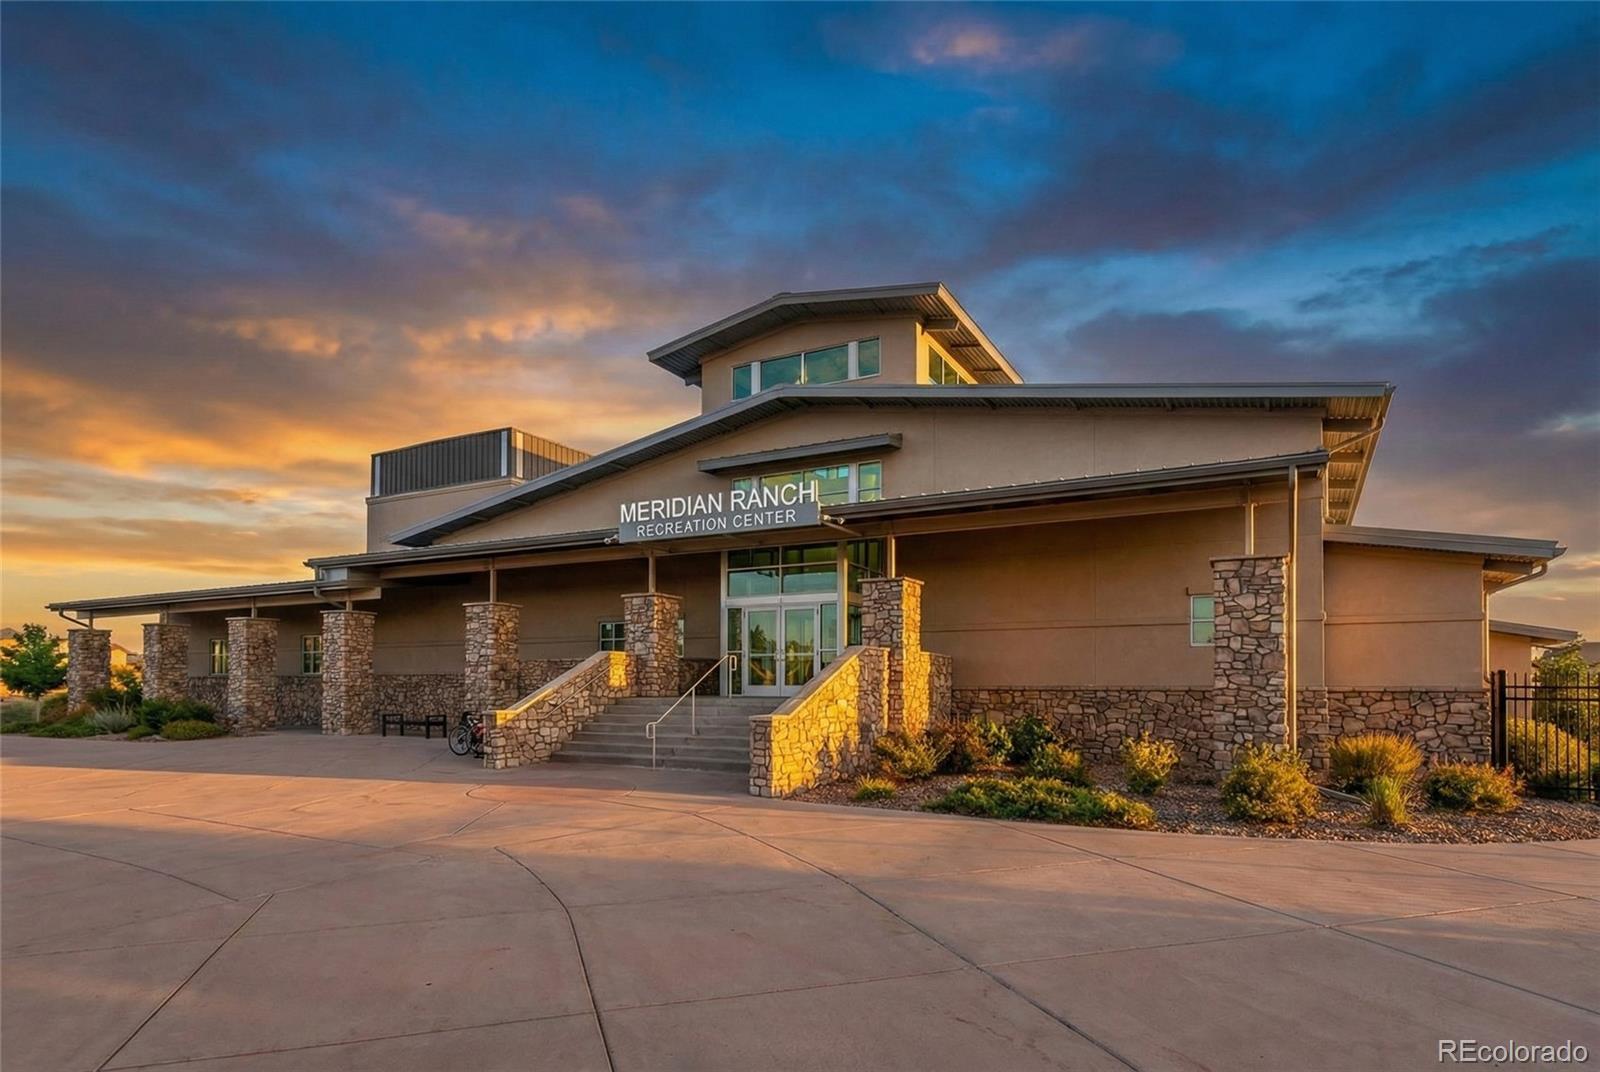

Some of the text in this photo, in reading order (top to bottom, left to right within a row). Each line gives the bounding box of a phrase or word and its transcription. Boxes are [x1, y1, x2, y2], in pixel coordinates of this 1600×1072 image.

[620, 480, 817, 523] MERIDIAN RANCH
[637, 509, 796, 537] RECREATION CENTER
